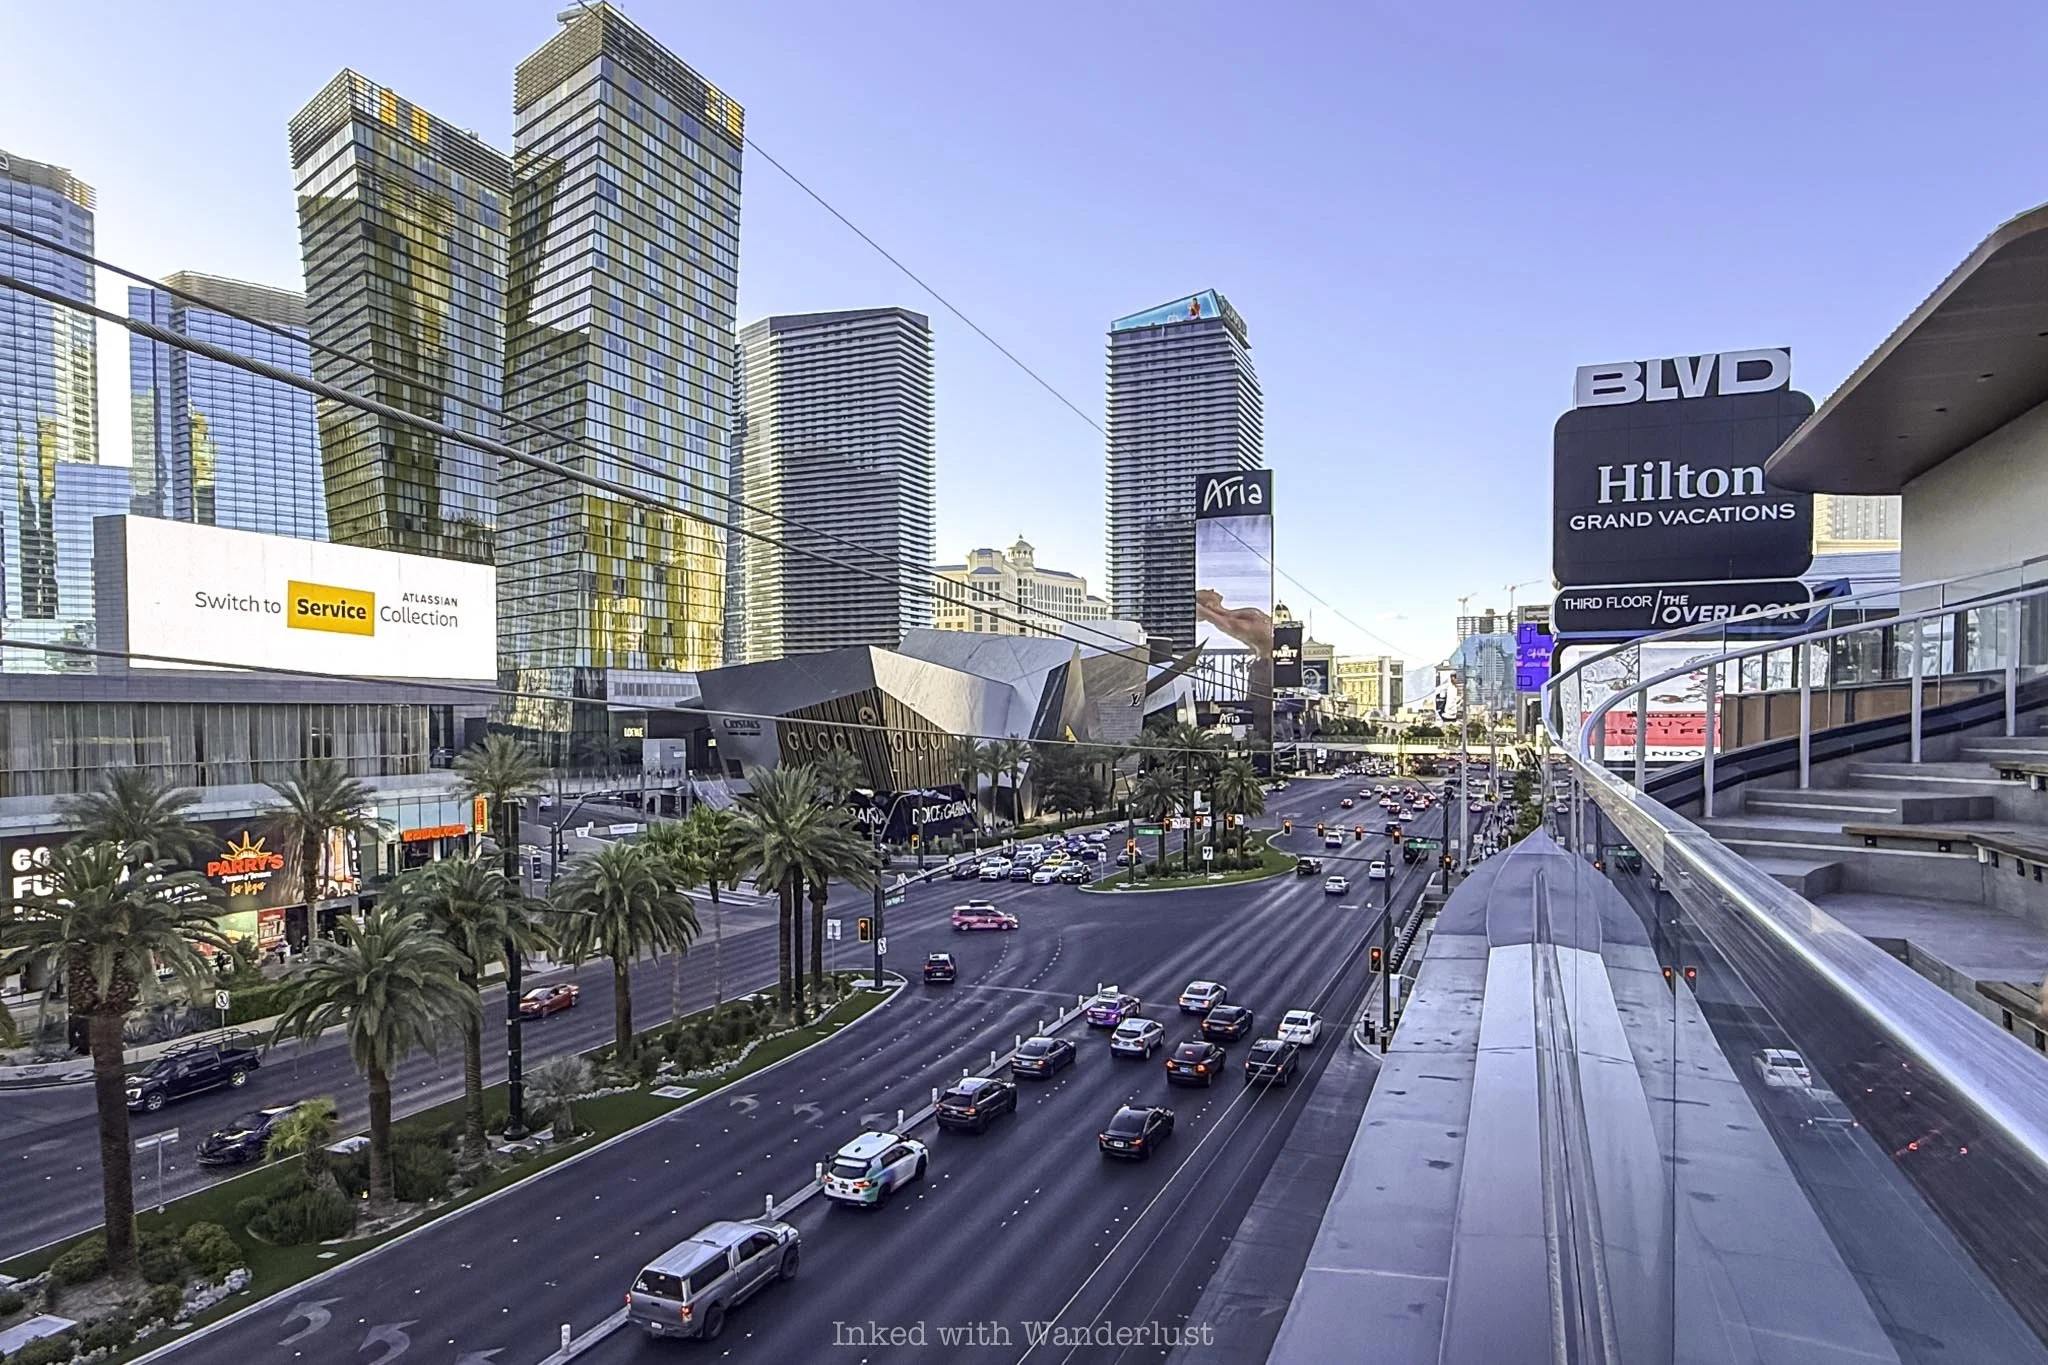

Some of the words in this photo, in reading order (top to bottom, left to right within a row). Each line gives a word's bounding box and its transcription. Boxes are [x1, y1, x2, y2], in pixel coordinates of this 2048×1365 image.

[1576, 349, 1790, 407] BLVD
[1203, 475, 1263, 511] Aria
[1598, 461, 1765, 504] Hilton
[1570, 511, 1653, 530] GRAND
[1658, 503, 1796, 525] VACATIONS
[195, 591, 260, 613] Switch
[264, 596, 281, 614] to
[297, 598, 367, 620] Service
[380, 606, 458, 628] Collection
[402, 592, 458, 607] ATLASSIAN
[1563, 598, 1602, 610] THIRD
[1606, 595, 1652, 609] FLOOR
[1662, 595, 1689, 606] THE
[1218, 713, 1241, 724] Aria
[892, 731, 947, 752] GUCCI
[208, 854, 284, 877] PARRY'S
